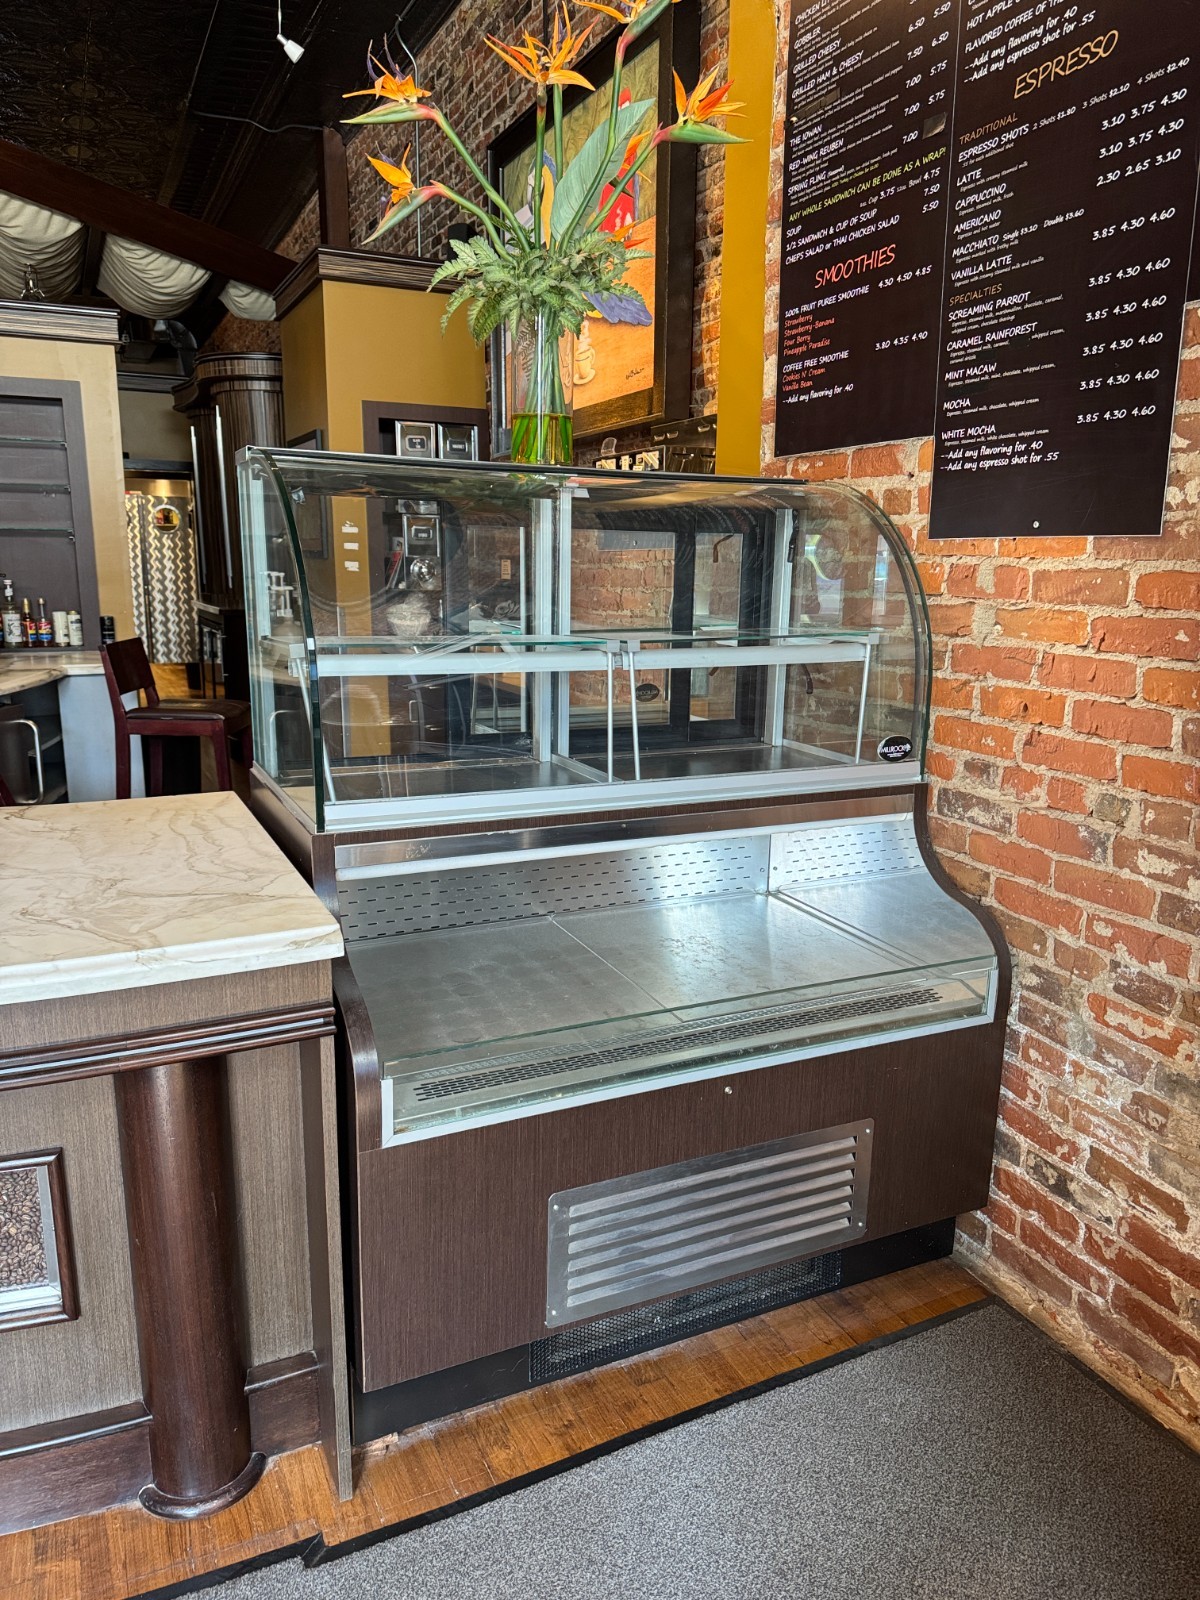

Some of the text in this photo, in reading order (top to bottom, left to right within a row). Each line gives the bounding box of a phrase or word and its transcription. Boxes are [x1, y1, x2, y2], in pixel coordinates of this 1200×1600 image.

[793, 26, 820, 49] GOBBLER
[795, 1, 820, 25] CHICKEN
[964, 0, 1047, 53] FLAVORED COFFEE OF
[966, 0, 1013, 30] HOT APPLE
[990, 44, 1006, 58] any
[1007, 24, 1044, 50] flavoring
[1045, 16, 1060, 30] for
[1061, 5, 1078, 23] .40
[791, 78, 815, 98] GRILLED
[816, 69, 830, 84] HAM
[838, 49, 864, 71] CHEESY
[908, 16, 925, 32] 6.50
[933, 1, 951, 18] 5.50
[792, 53, 817, 74] GRILLED
[817, 37, 841, 59] CHEESY
[907, 31, 949, 60] 7.50 6.50
[989, 54, 1005, 72] any
[1006, 35, 1041, 63] espresso
[1041, 28, 1060, 46] shot
[1062, 21, 1077, 35] for
[1078, 10, 1096, 26] .55
[1013, 29, 1118, 99] ESPRESSO
[789, 59, 947, 147] THE IOWAN 7.00 5.75
[958, 57, 1190, 162] ESPRESSO SHOTS Shots $1.80 Shots $2.10 Shots $2.40
[959, 112, 1018, 145] TRADITIONAL
[788, 89, 945, 171] RED-WING REUBEN 7.00 5.75
[956, 88, 1187, 186] LATTE 3.10 3.75 4.30
[787, 179, 808, 196] SPRING
[809, 170, 826, 185] FLING
[902, 130, 918, 144] 7.00
[788, 146, 946, 222] ANY WHOLE SANDWICH CAN DONE AS WRAP!
[955, 118, 1184, 210] CAPPUCCINO 3.10 3.75 4.30
[786, 166, 941, 238] SOUP 3.75 Bowl 4.75
[786, 183, 940, 251] 1/2 SANDWICH CUP SOUP 7.50
[953, 148, 1181, 234] AMERICANO 2.30 2.65 3.10
[805, 243, 824, 258] SALAD
[832, 234, 847, 247] THAI
[848, 223, 876, 241] CHICKEN
[877, 214, 899, 230] SALAD
[922, 200, 939, 213] 5.50
[951, 208, 1084, 258] MACCHIATO Single $3.10 Double $3.60
[951, 207, 1175, 280] VANILLA LATTE 3.85 4.30 4.60
[800, 301, 817, 313] FRUIT
[817, 294, 837, 307] PUREE
[837, 284, 869, 302] SMOOTHIE
[878, 277, 894, 288] 4.30
[896, 271, 912, 282] 4.50
[915, 264, 932, 276] 4.85
[814, 243, 896, 288] SMOOTHIES
[948, 257, 1170, 321] SCREAMING PARROT 3.85 4.30 4.60
[784, 314, 812, 328] Strawberry
[949, 283, 1002, 306] SPECIALTIES
[946, 295, 1167, 351] CARAMEL RAINFOREST 3.85 4.30 4.60
[782, 331, 928, 373] COFFEE FREE SMOOTHIE 3.80 4.35 4.90
[944, 332, 1163, 381] MINT MACAW 3.85 4.30 4.60
[809, 387, 833, 399] flavoring
[942, 368, 1159, 410] MOCHA 3.85 4.30 4.60
[941, 405, 1156, 440] WHITE MOCHA 3.85 4.30 4.60
[979, 443, 1013, 456] flavoring
[1014, 441, 1027, 452] for
[963, 461, 977, 471] any
[978, 458, 1009, 470] espresso
[1010, 454, 1028, 464] shot
[1029, 452, 1042, 463] for
[1044, 451, 1059, 461] .55
